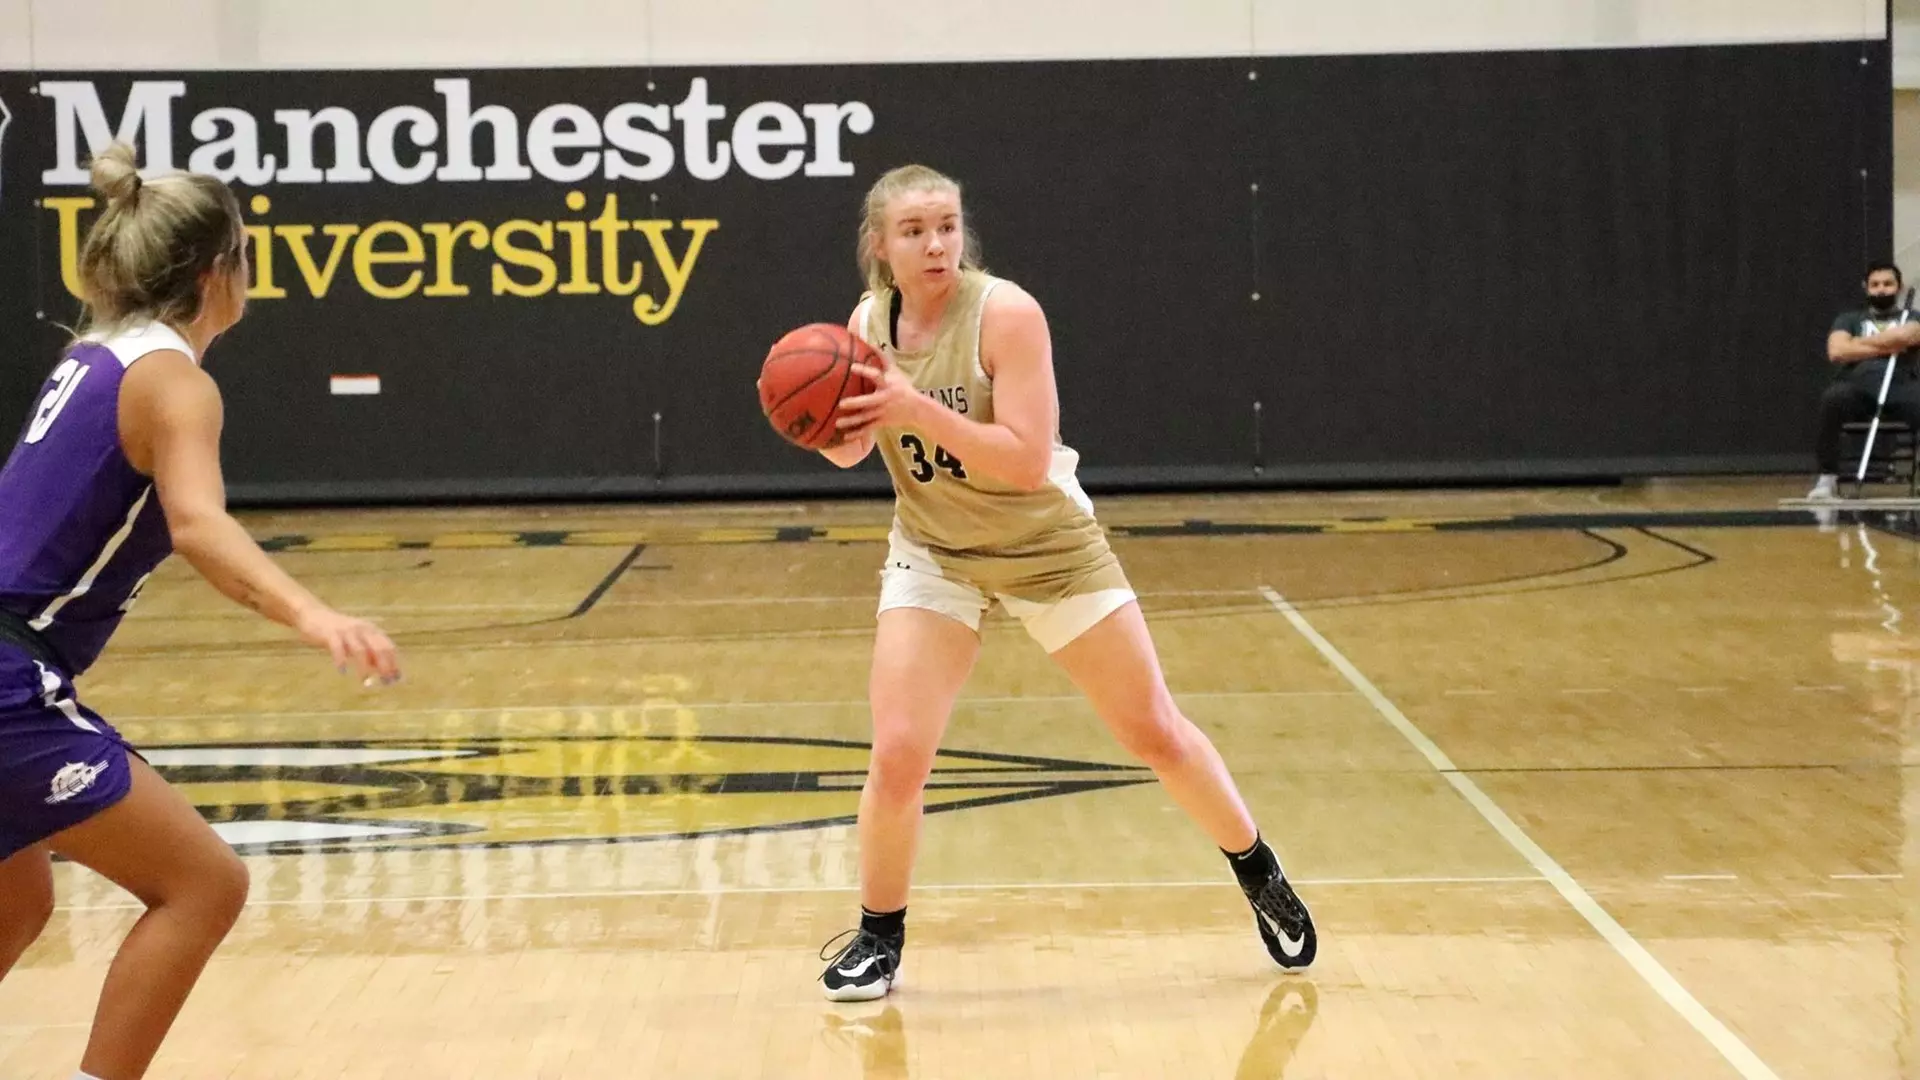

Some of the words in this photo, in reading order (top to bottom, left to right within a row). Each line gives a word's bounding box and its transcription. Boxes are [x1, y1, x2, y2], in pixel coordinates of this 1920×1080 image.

[40, 78, 874, 186] Manchester
[42, 191, 719, 325] Uiversity
[24, 358, 91, 444] 21
[921, 386, 968, 414] NS
[899, 433, 968, 484] 34
